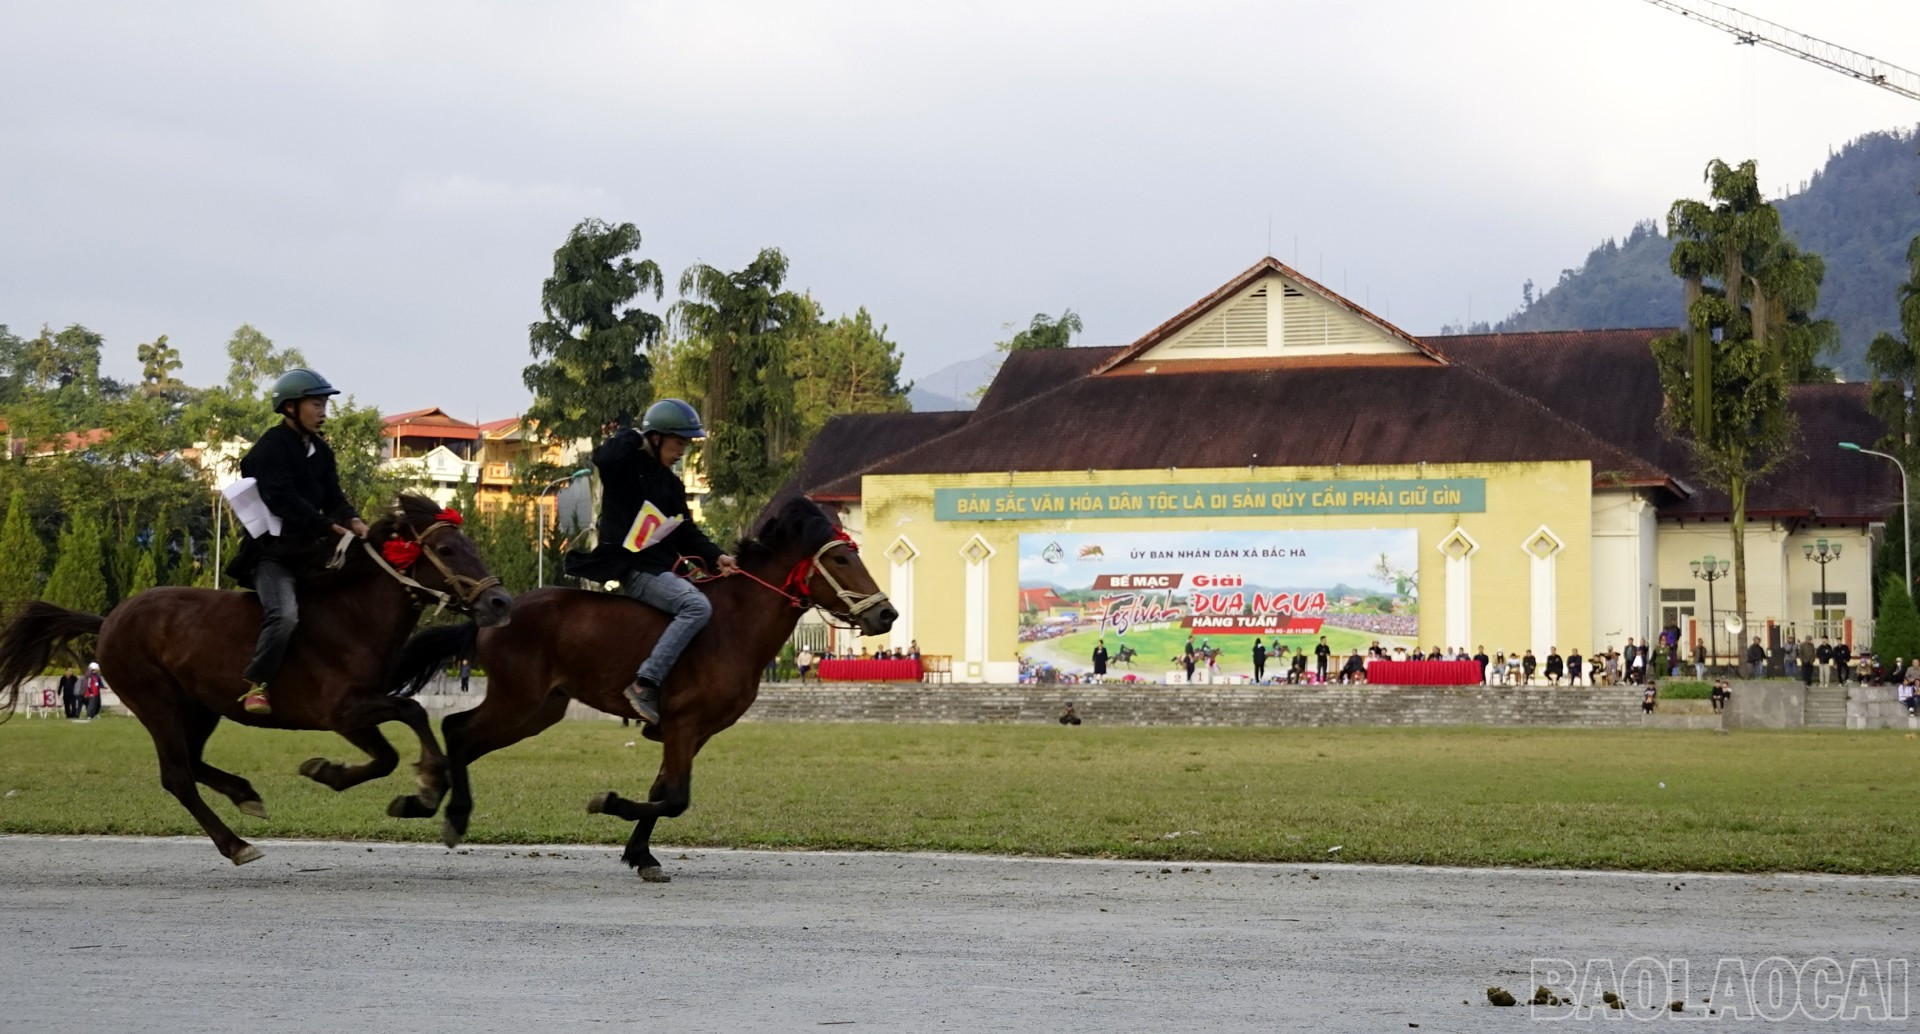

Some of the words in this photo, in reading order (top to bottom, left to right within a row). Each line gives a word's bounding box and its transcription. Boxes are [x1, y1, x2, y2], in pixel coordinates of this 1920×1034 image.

[957, 492, 990, 513] BẢN
[996, 492, 1026, 513] SẮC
[1031, 493, 1064, 512] VĂN
[1070, 492, 1103, 512] HÓA
[1109, 492, 1142, 511] DÂN
[1147, 491, 1178, 513] TỘC
[1183, 490, 1205, 510] LÀ
[1210, 494, 1227, 510] DI
[1233, 488, 1266, 509] SẢN
[1312, 486, 1347, 508] CẦN
[1353, 485, 1393, 506] PHẢI
[1400, 486, 1428, 505] GIỮ
[1433, 489, 1461, 505] GÌN
[1150, 550, 1173, 559] BAN
[1178, 548, 1210, 558] NHÂN
[1215, 547, 1239, 558] DÂN
[1262, 545, 1286, 557] BẮC
[1290, 546, 1306, 557] HÀ
[1133, 576, 1169, 589] MẠC
[1193, 592, 1244, 613] ĐUA
[1192, 615, 1233, 627] HÀNG
[45, 690, 56, 706] 3
